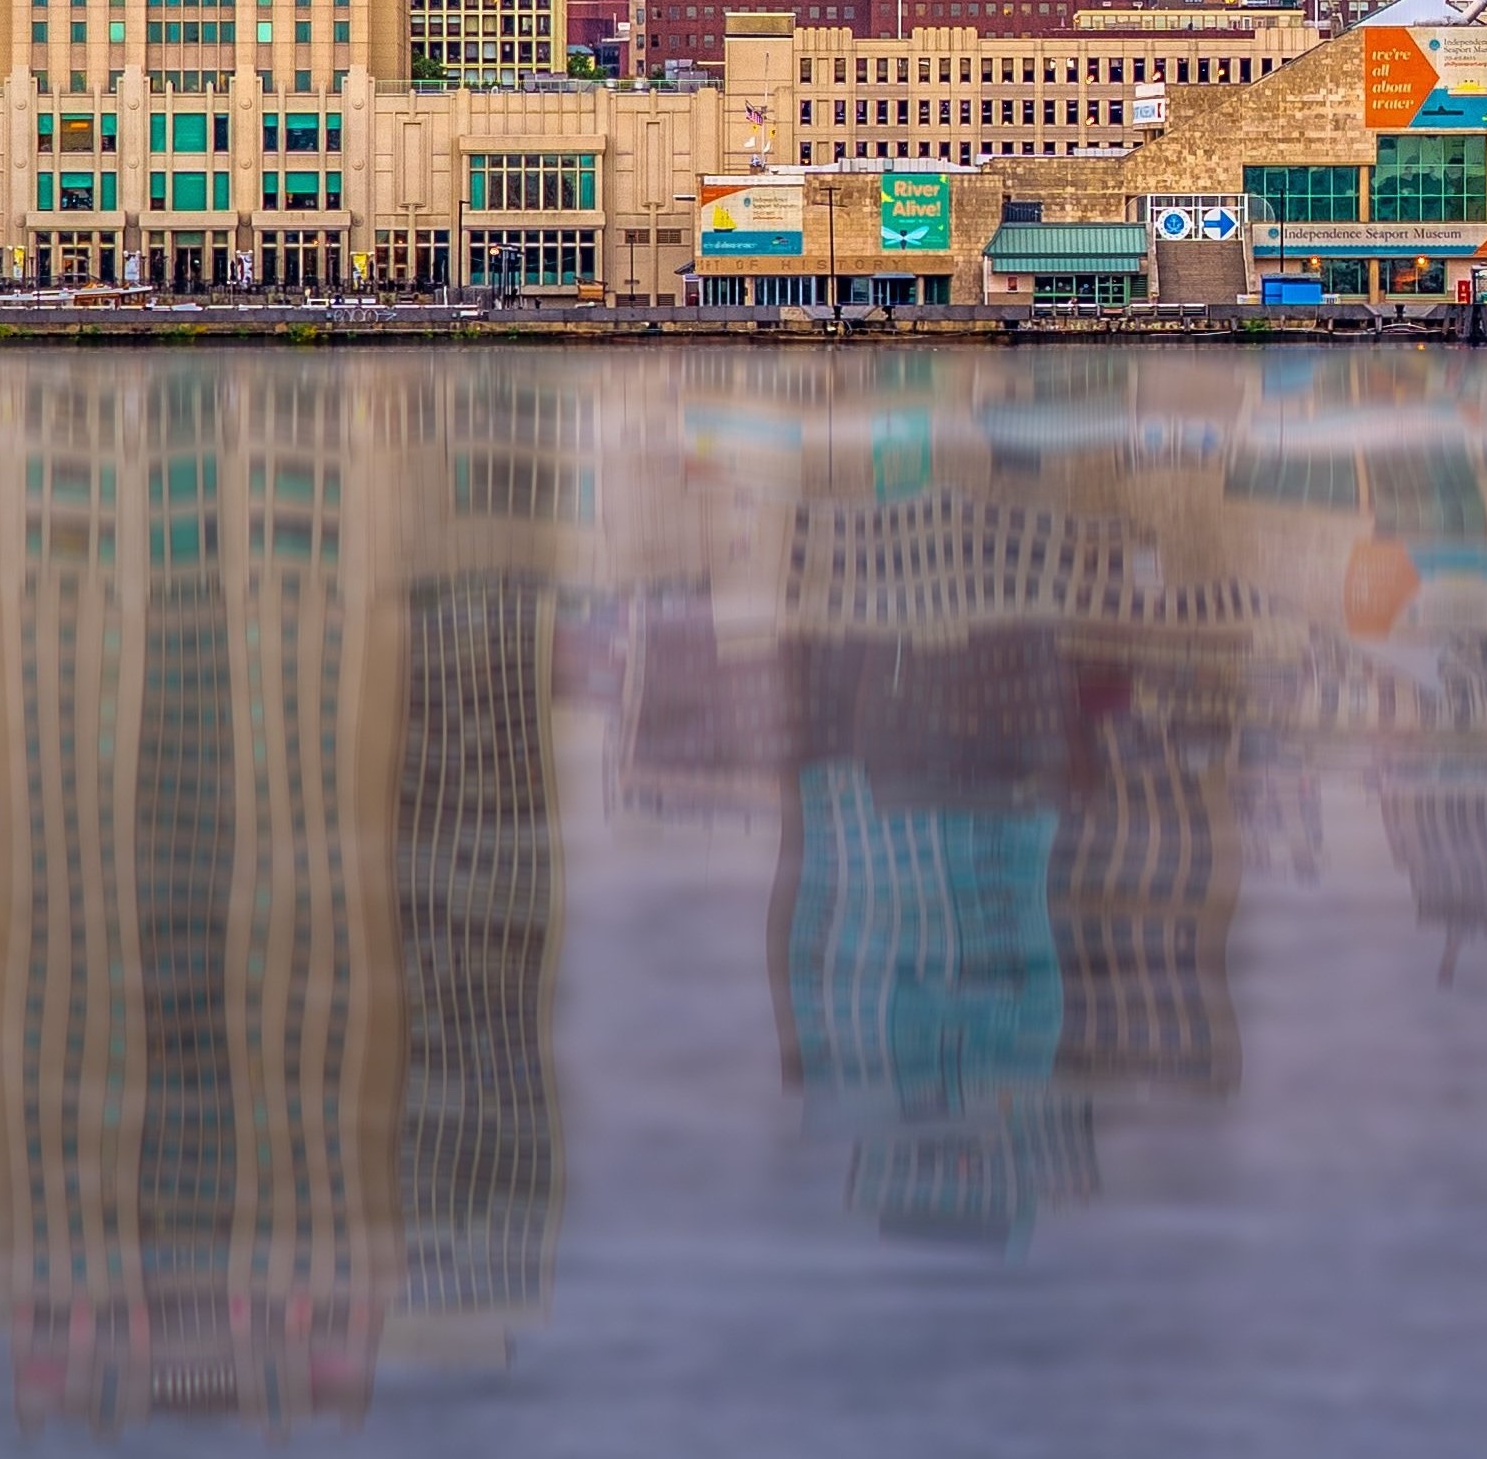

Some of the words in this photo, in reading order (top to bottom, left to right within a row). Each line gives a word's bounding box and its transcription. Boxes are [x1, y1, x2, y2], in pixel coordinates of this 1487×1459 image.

[1372, 48, 1412, 61] we're
[1444, 46, 1471, 54] Seaport
[1372, 64, 1389, 77] all
[1372, 80, 1412, 93] about
[1372, 99, 1414, 109] water
[894, 180, 940, 197] River
[893, 200, 941, 217] Alive!
[1284, 228, 1362, 244] Independence
[1365, 228, 1409, 244] Seaport
[1413, 228, 1462, 239] Museum
[736, 260, 759, 270] OF
[781, 260, 901, 271] HISTORY
